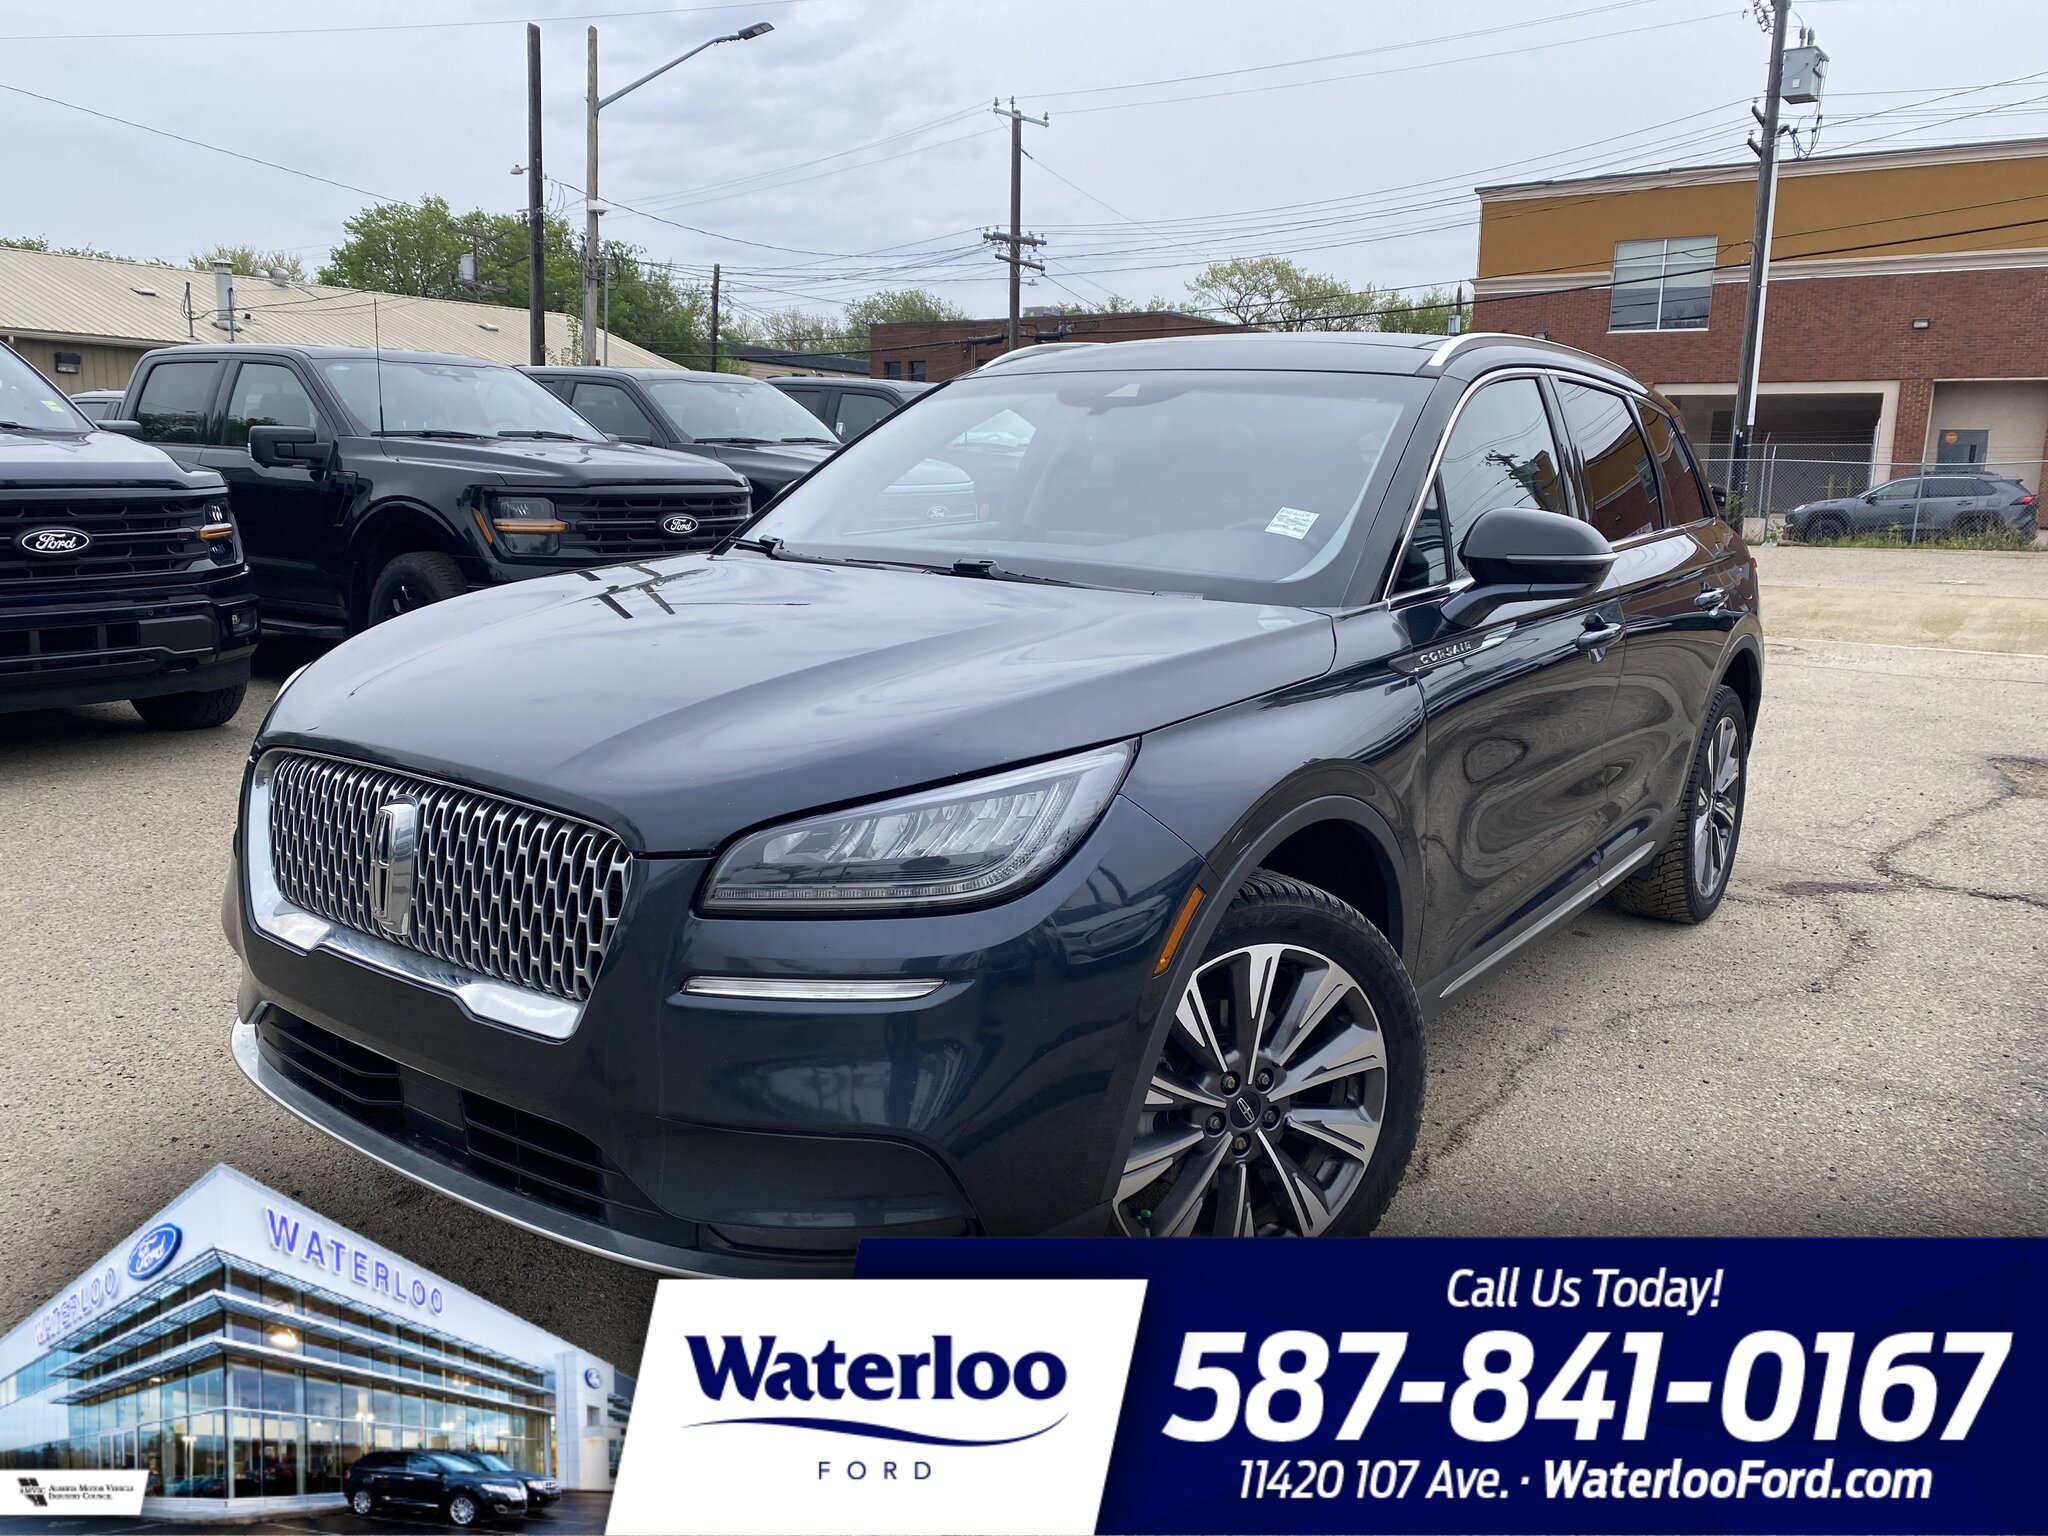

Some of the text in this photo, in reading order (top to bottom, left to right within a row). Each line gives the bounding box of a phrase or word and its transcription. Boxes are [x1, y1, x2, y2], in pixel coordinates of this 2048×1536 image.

[670, 518, 692, 531] Ford
[35, 533, 77, 550] Ford
[1420, 641, 1472, 664] CORSAIR
